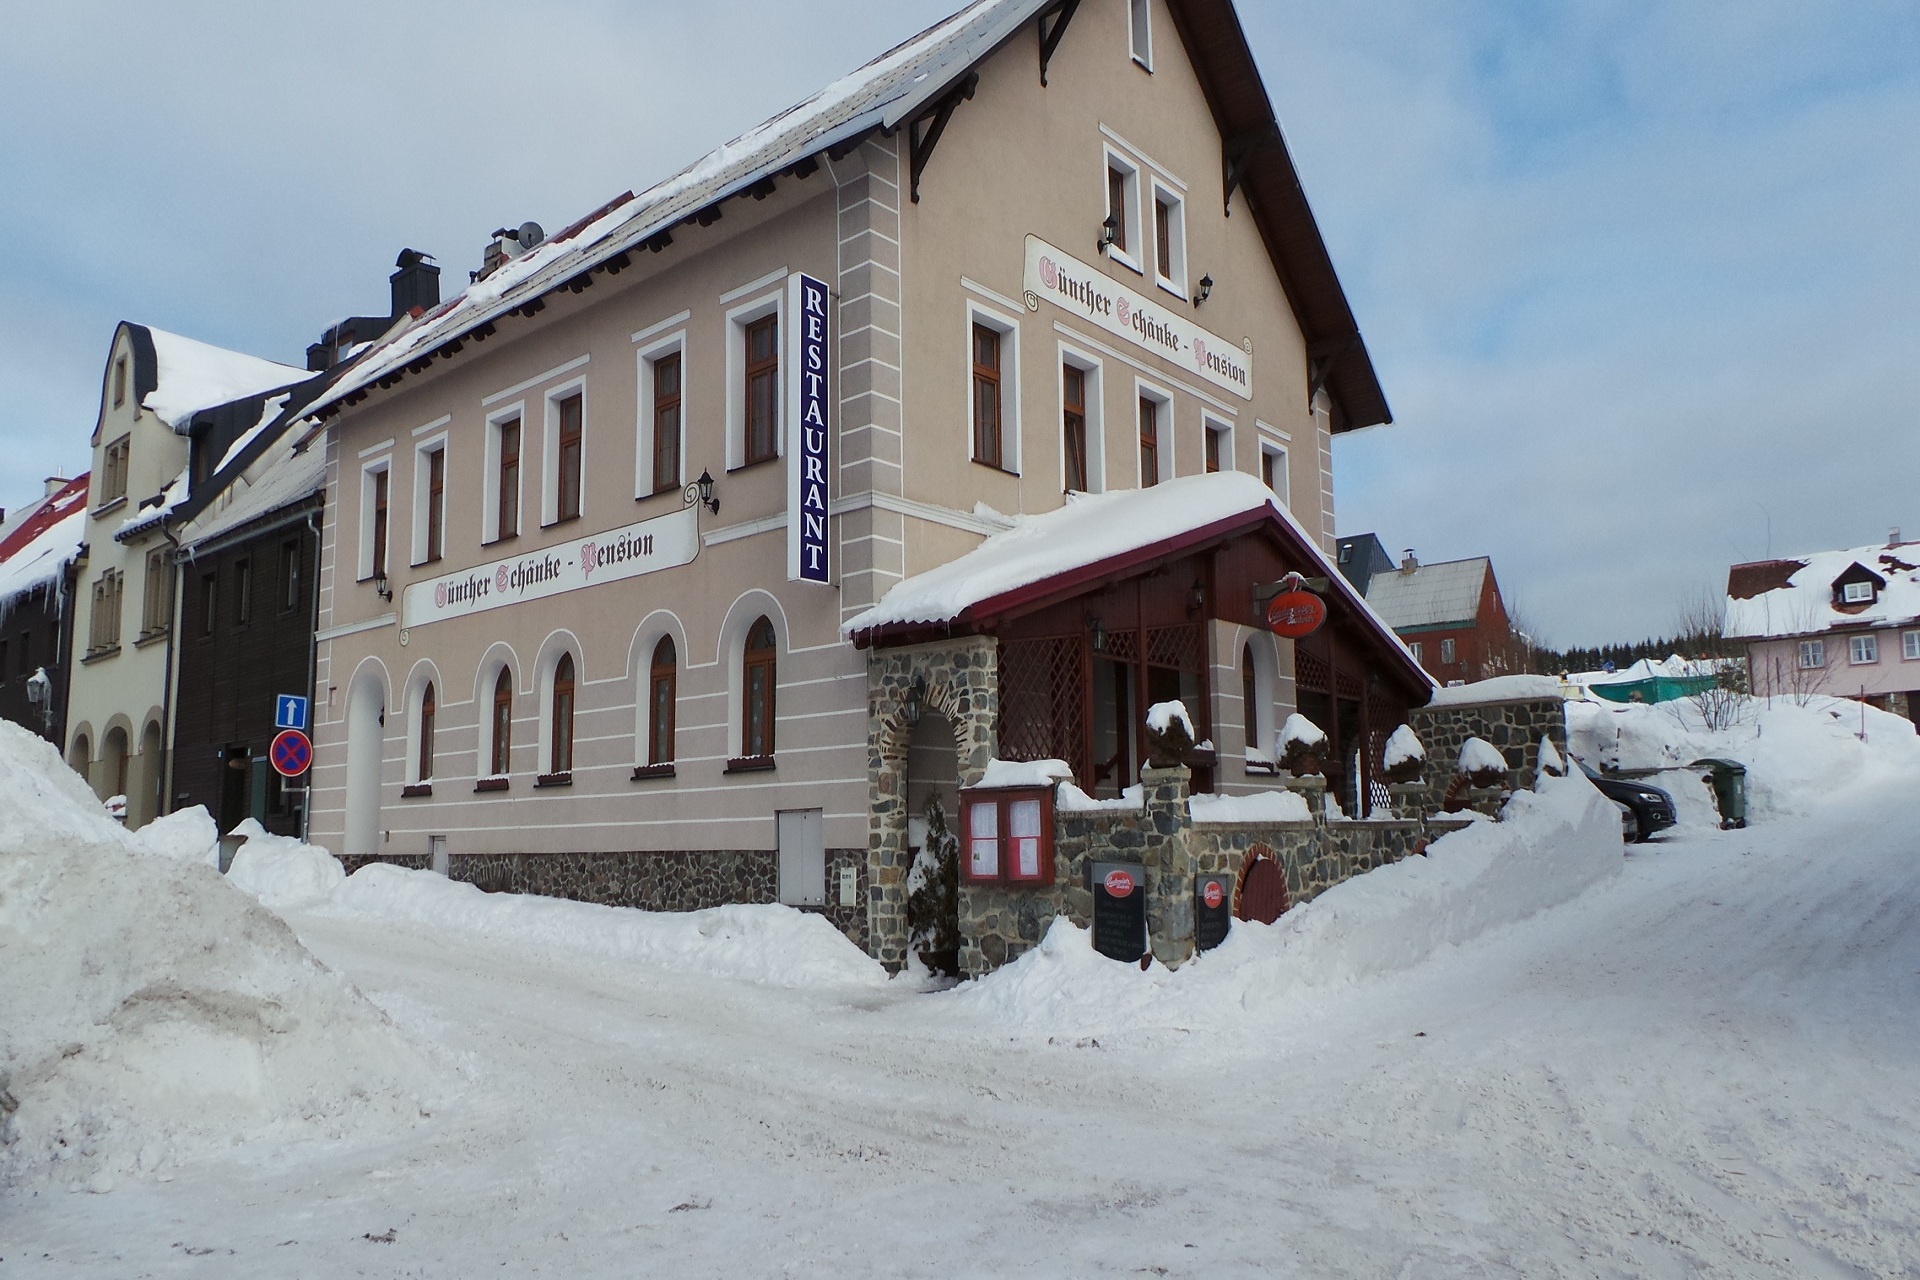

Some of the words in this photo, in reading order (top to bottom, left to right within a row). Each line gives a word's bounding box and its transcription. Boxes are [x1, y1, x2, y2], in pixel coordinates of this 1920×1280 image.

[1039, 256, 1111, 316] Günther
[1116, 297, 1179, 351] Schänke
[1193, 338, 1246, 386] Pension
[804, 285, 825, 570] RESTAURANT
[435, 574, 490, 608] Günther
[495, 553, 561, 596] Schänke
[581, 532, 653, 580] Pension
